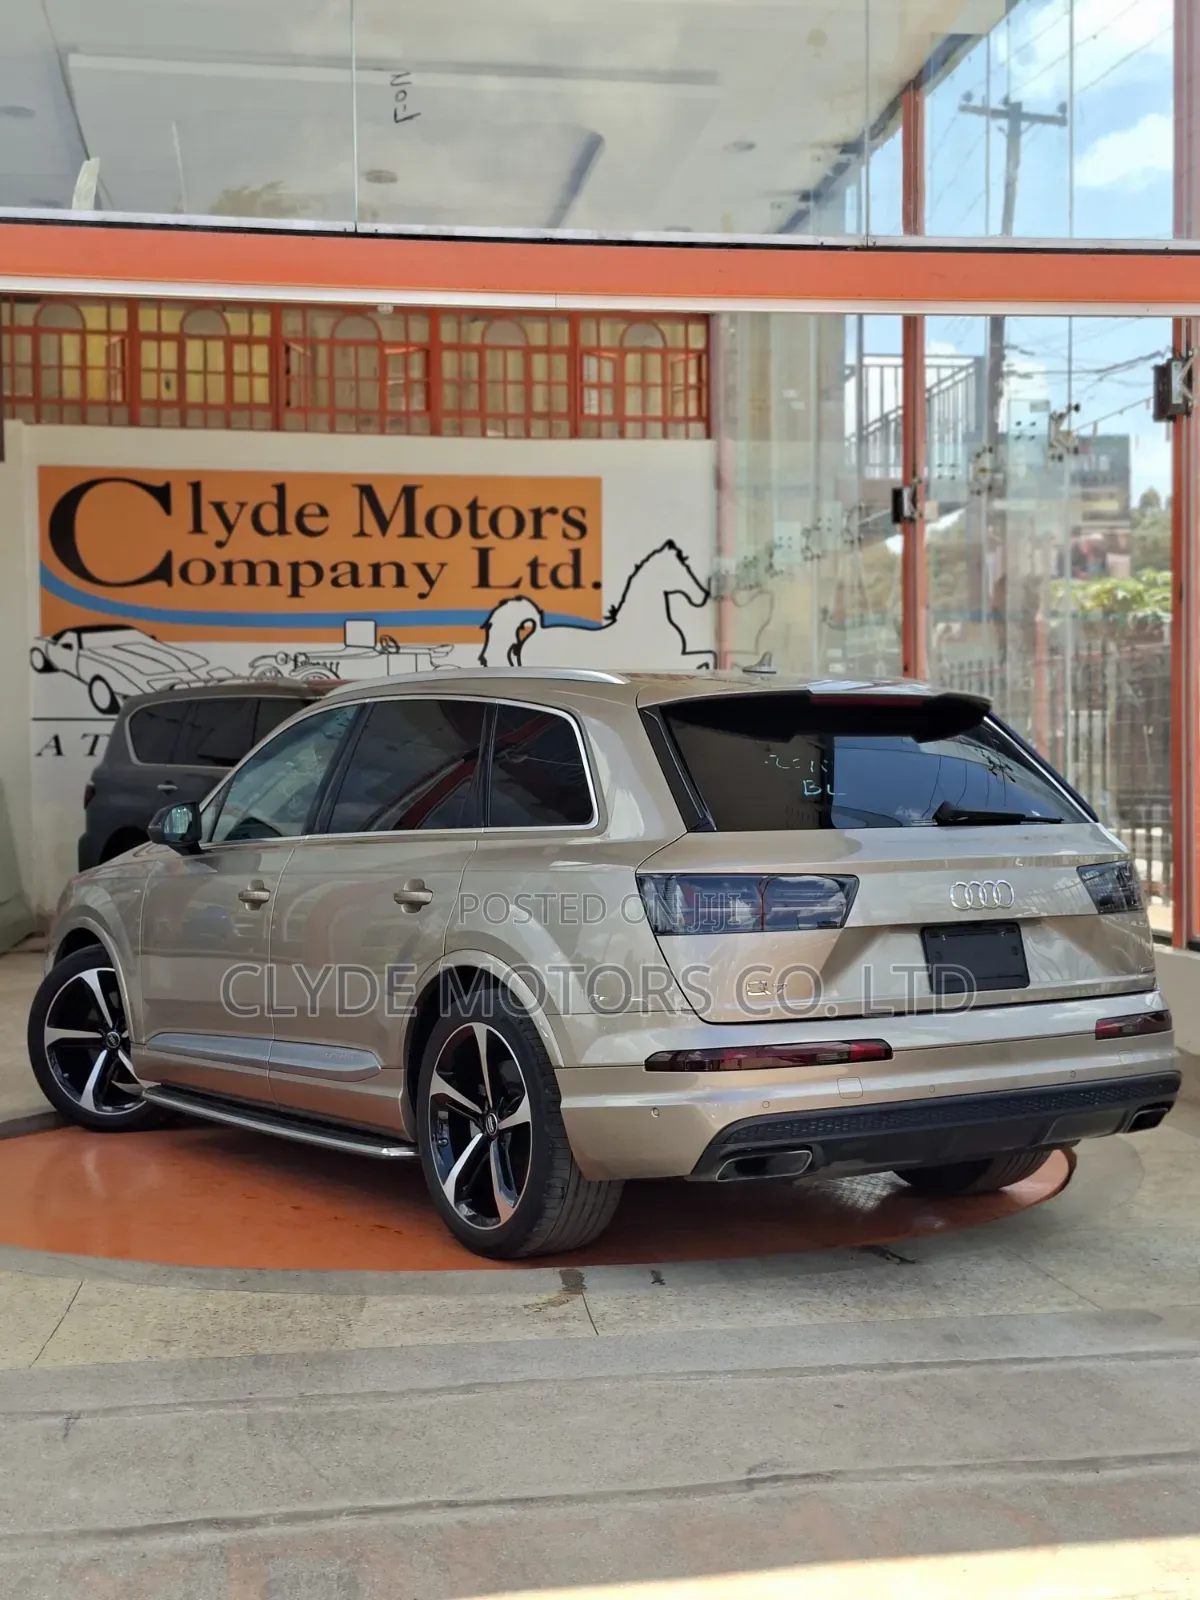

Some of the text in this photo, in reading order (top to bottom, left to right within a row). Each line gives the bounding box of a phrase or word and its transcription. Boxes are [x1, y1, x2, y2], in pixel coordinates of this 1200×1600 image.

[48, 477, 588, 588] Clyde Motors
[471, 546, 602, 590] Ltd.
